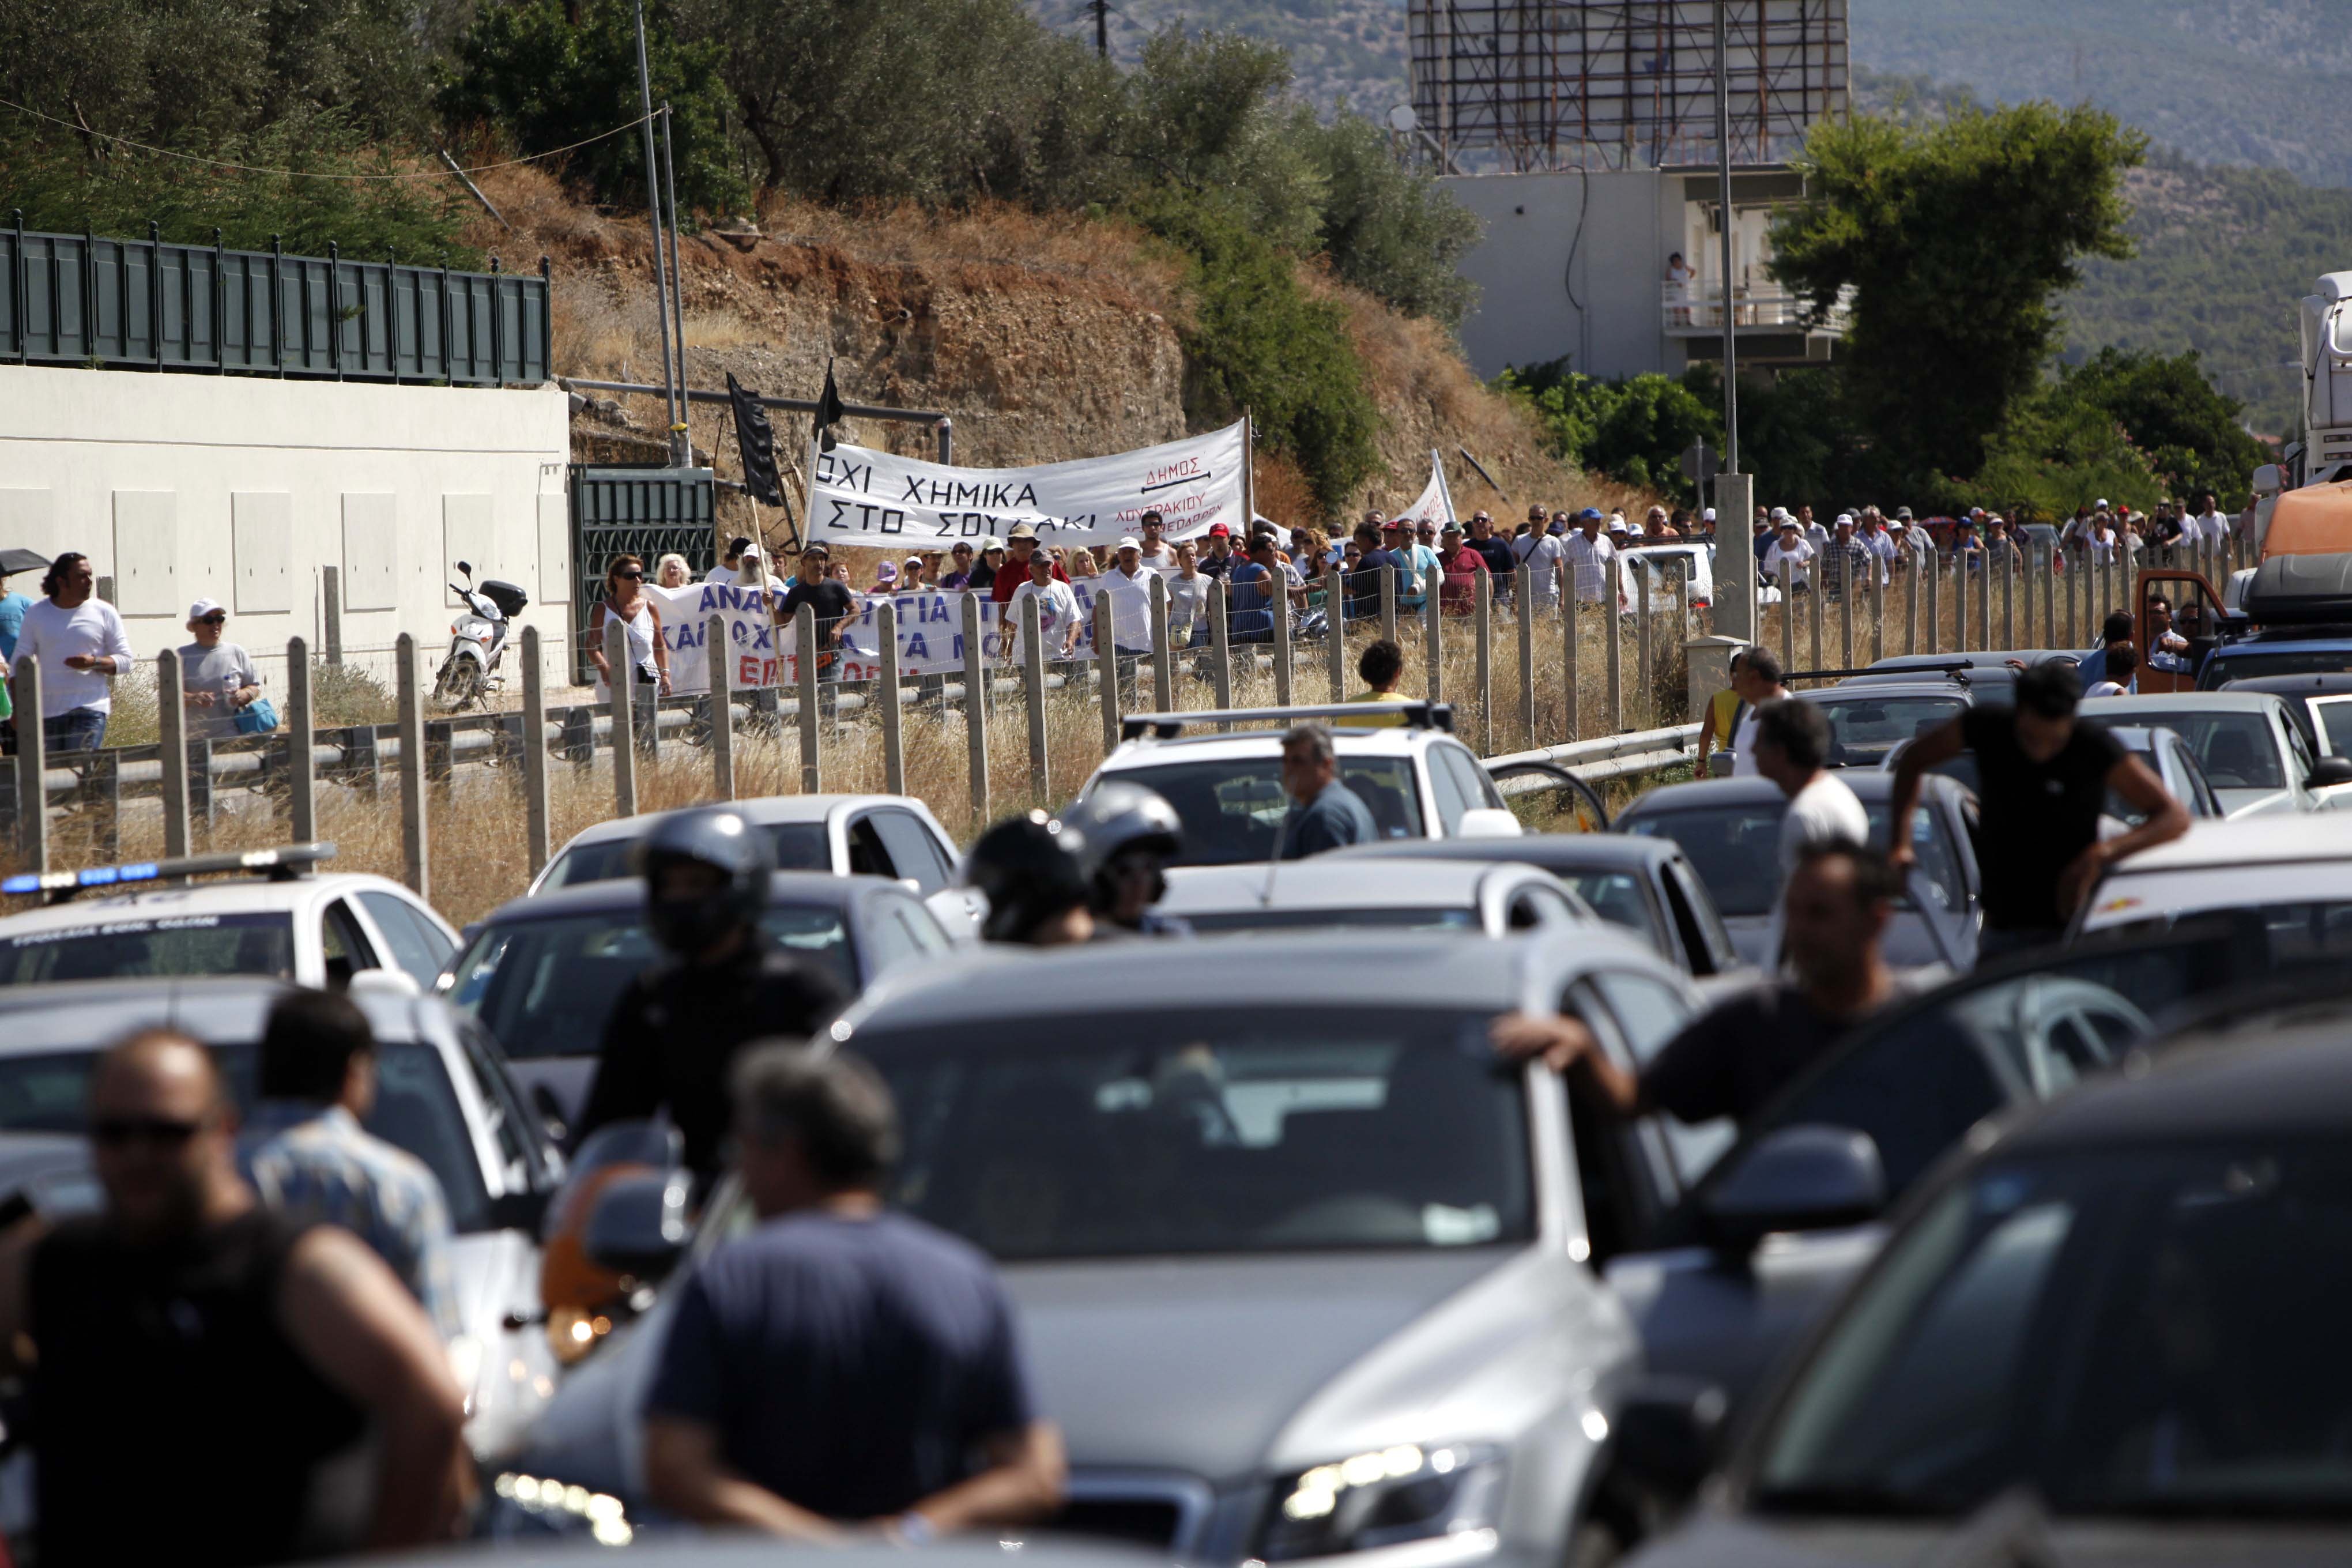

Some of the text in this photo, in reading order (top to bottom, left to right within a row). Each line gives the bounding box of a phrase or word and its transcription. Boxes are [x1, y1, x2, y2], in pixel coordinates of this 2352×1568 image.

[815, 453, 1038, 508] ΟΧΙ ΧΗΜΙΚΑ
[1146, 457, 1201, 485] ΔΗΜΟΣ
[828, 499, 904, 534] ΣΤΟ
[895, 596, 950, 623] ΓΙΑ
[661, 621, 705, 651] ΚΑΙ
